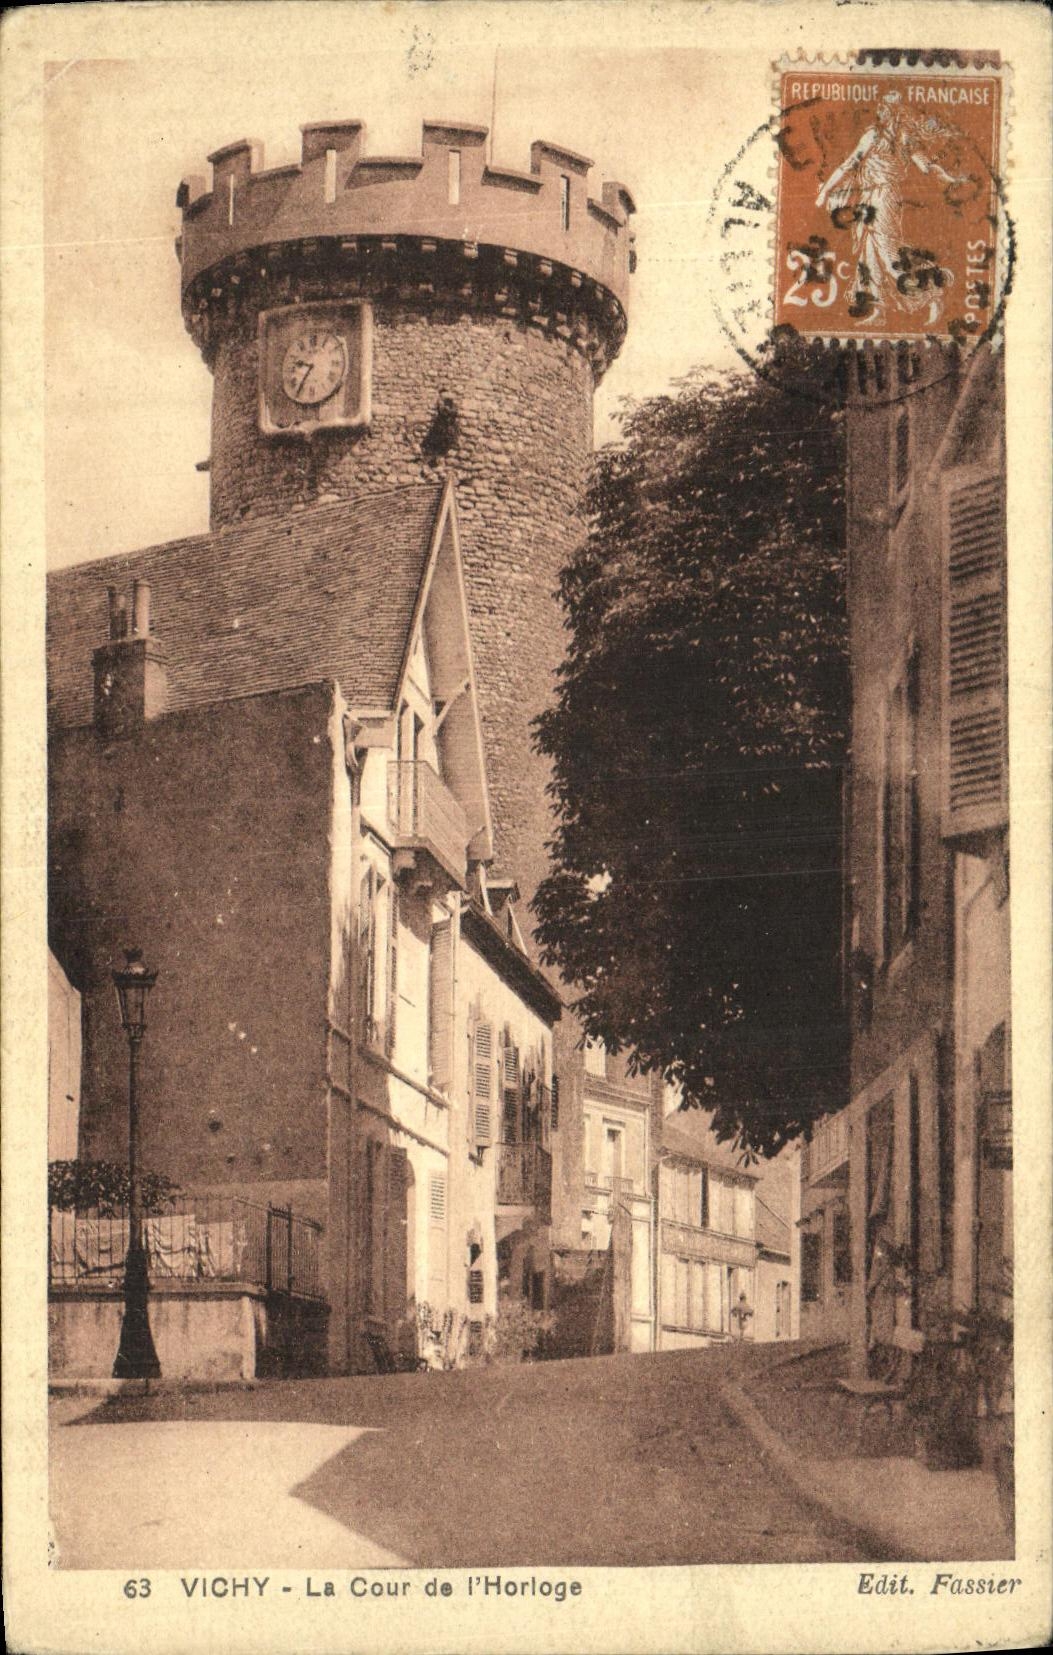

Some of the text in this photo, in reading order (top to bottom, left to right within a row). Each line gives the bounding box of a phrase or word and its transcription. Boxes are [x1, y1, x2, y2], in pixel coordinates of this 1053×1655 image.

[907, 85, 990, 106] FRANÇAISE
[964, 239, 987, 324] POSTES
[124, 1578, 152, 1599] 63
[181, 1577, 270, 1598] VICHY
[306, 1577, 335, 1598] La
[350, 1577, 411, 1598] Cour
[425, 1576, 453, 1598] de
[468, 1576, 583, 1602] l'Horloge
[857, 1573, 1022, 1596] Edit. Fassier
